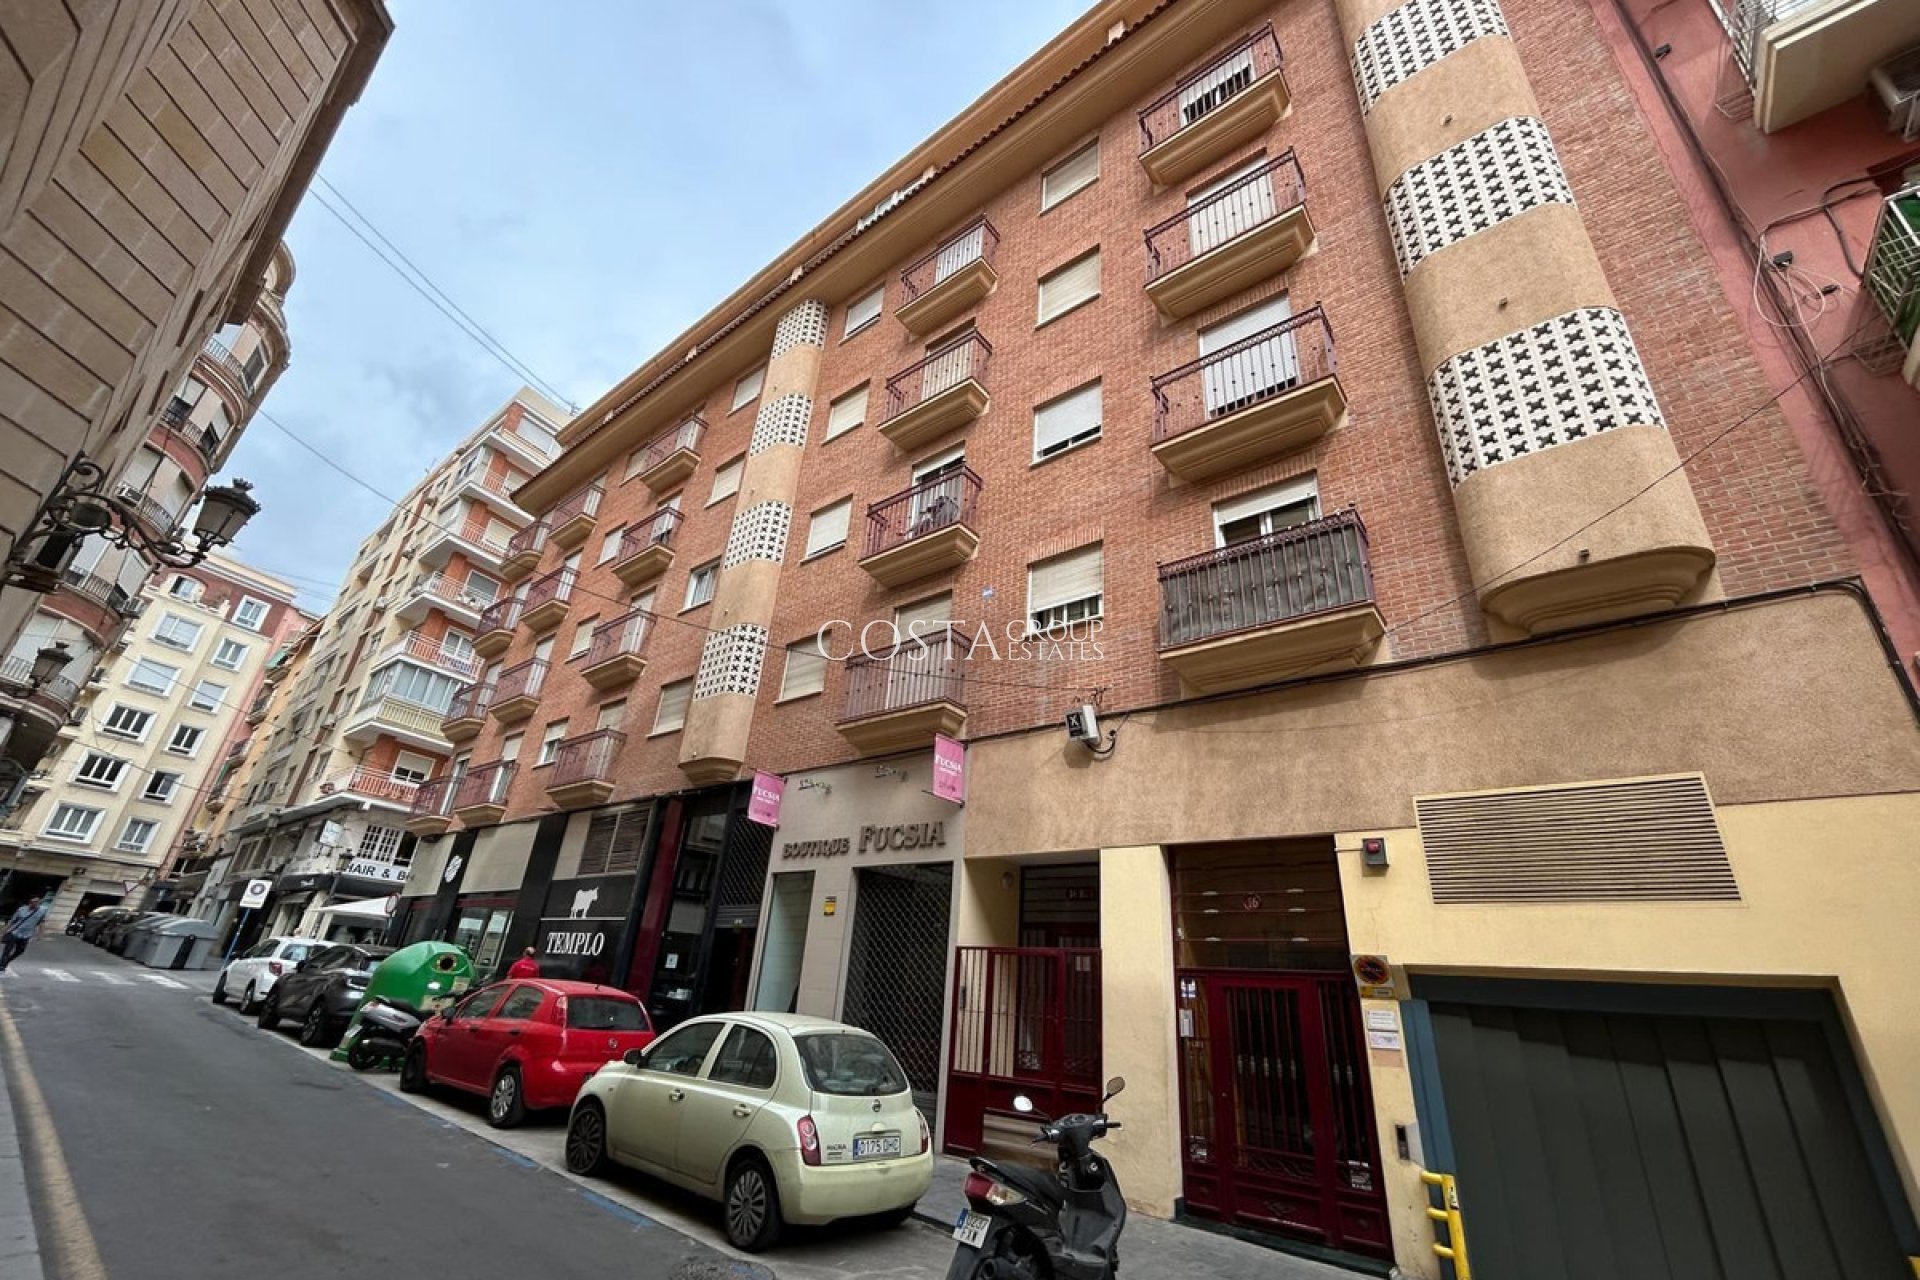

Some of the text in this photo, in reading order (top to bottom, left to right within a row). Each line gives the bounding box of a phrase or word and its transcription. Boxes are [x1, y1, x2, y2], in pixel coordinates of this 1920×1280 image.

[935, 754, 962, 774] FUCSIA
[752, 785, 780, 802] FUCSIA
[782, 821, 947, 860] BOUTIQUE FUCSIA
[545, 932, 605, 956] TEMPLO
